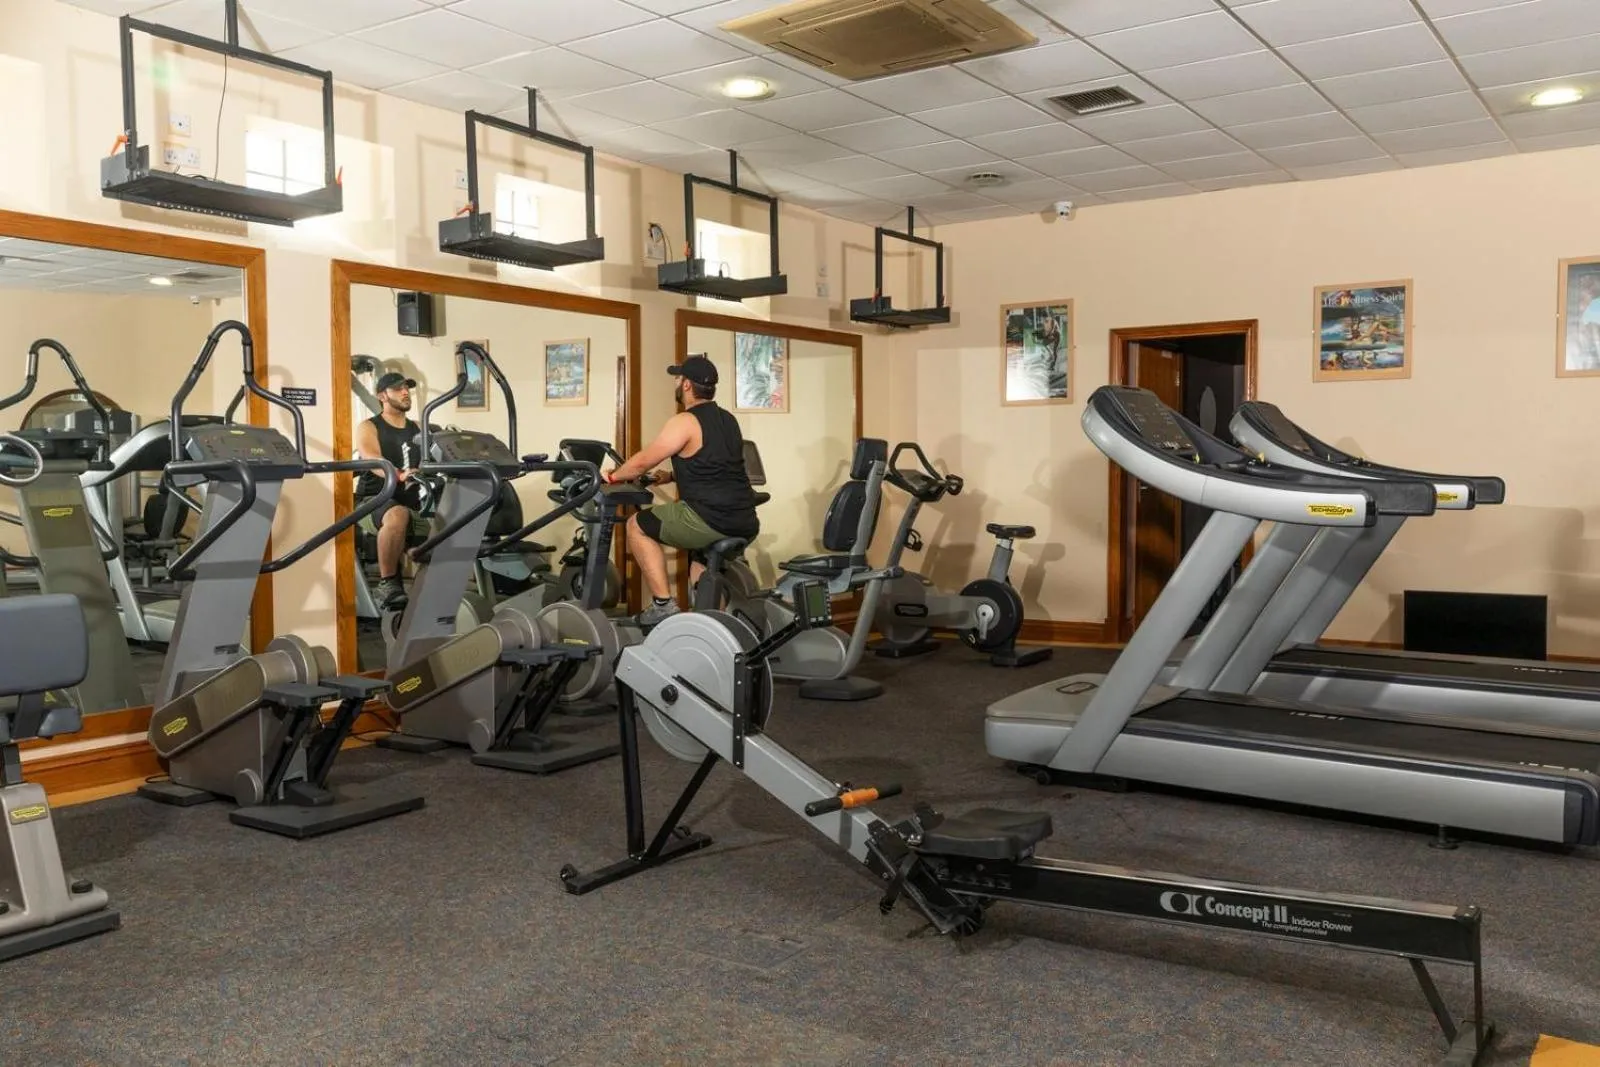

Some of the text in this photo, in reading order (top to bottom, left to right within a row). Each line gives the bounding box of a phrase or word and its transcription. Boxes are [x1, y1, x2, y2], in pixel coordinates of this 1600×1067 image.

[1205, 896, 1352, 932] Concept II Indoor Rower
[1262, 920, 1273, 928] The
